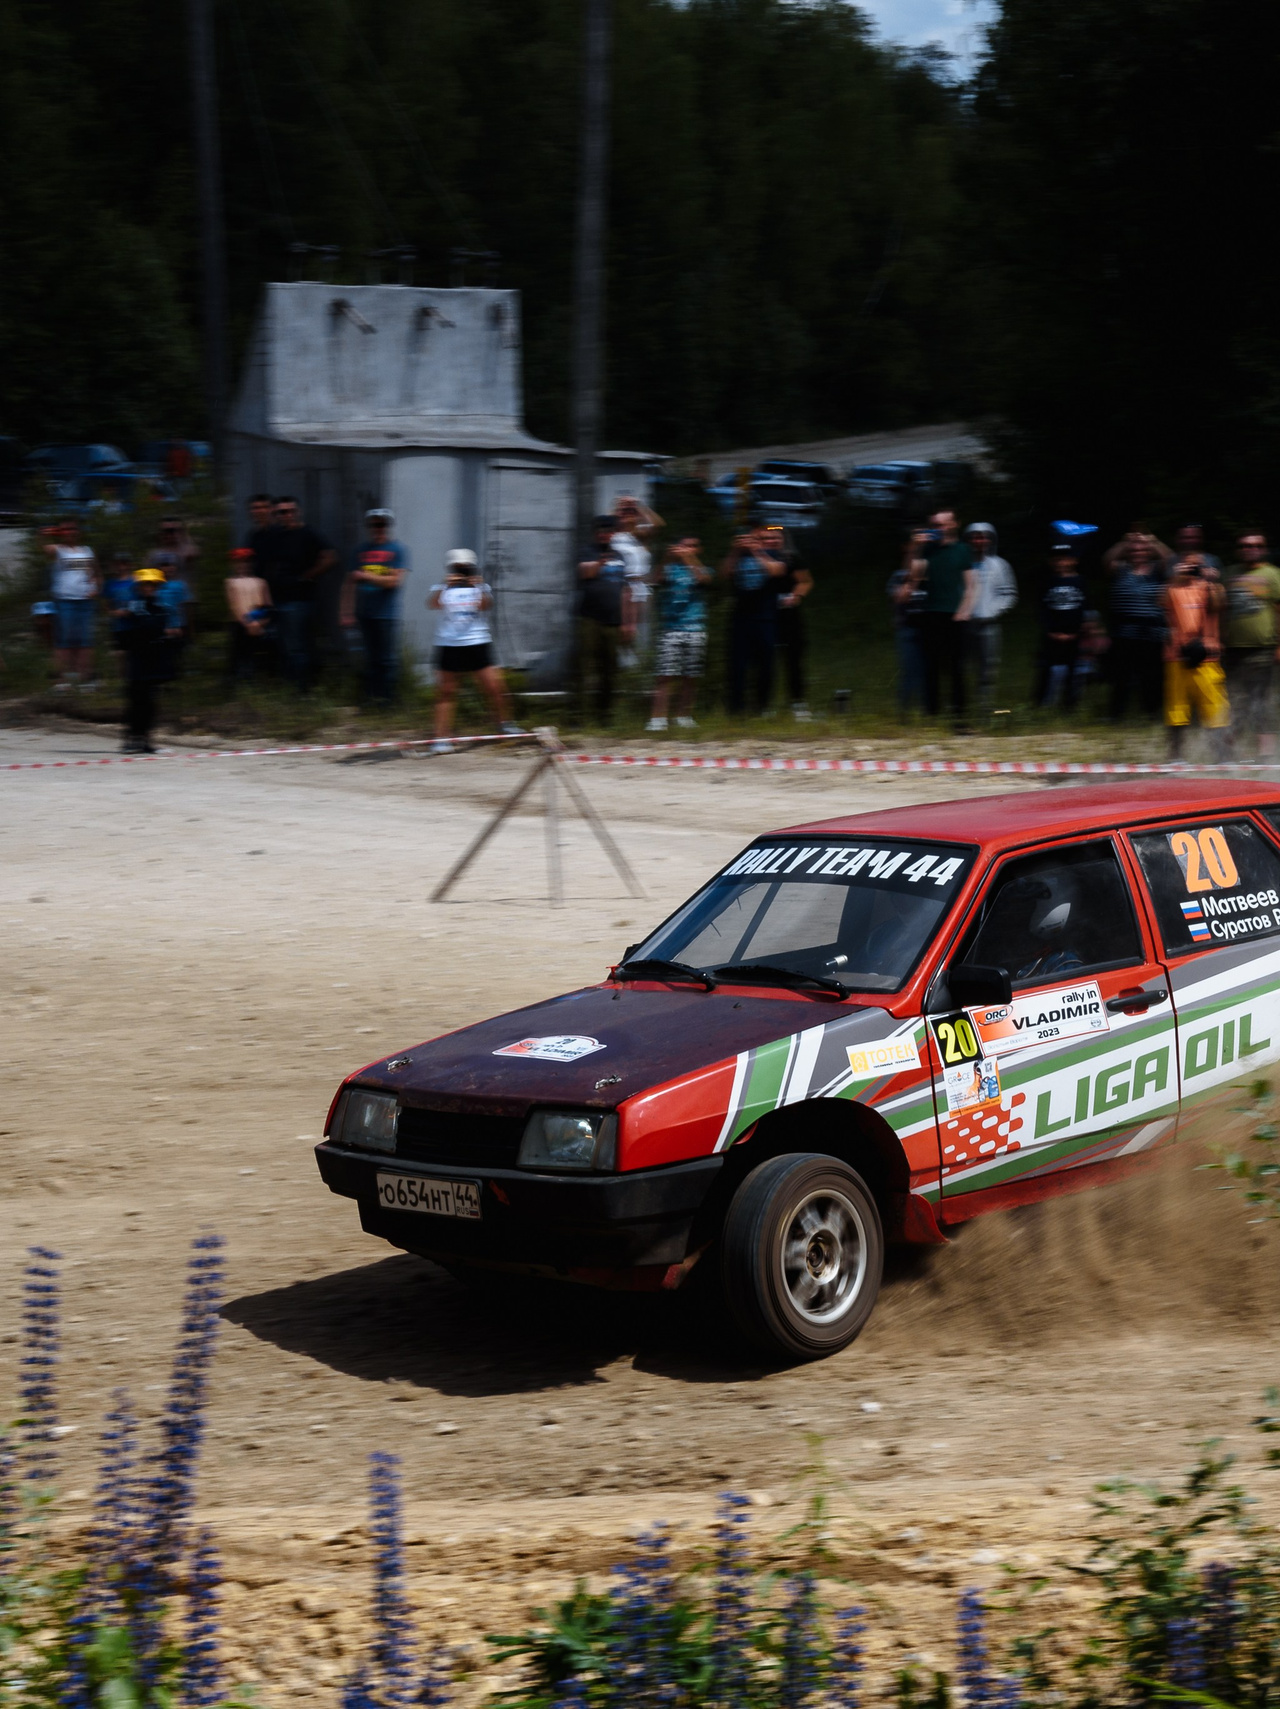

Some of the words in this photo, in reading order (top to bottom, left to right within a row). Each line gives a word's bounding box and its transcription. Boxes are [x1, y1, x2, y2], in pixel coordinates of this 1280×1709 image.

[721, 847, 821, 877] RALLY
[806, 847, 912, 880] TEAM
[902, 855, 965, 886] 44
[1171, 827, 1239, 894] 20
[1201, 889, 1280, 918] Матвеев
[1210, 914, 1272, 940] Суратов
[1061, 991, 1085, 1005] rally
[1086, 989, 1097, 1000] in
[1012, 1002, 1100, 1031] VLADIMIR
[938, 1018, 979, 1064] 20
[1037, 1027, 1060, 1039] 2023
[1034, 1045, 1170, 1139] LIGA
[1183, 1013, 1271, 1081] OIL
[455, 1183, 474, 1208] 44
[456, 1206, 470, 1215] RUS
